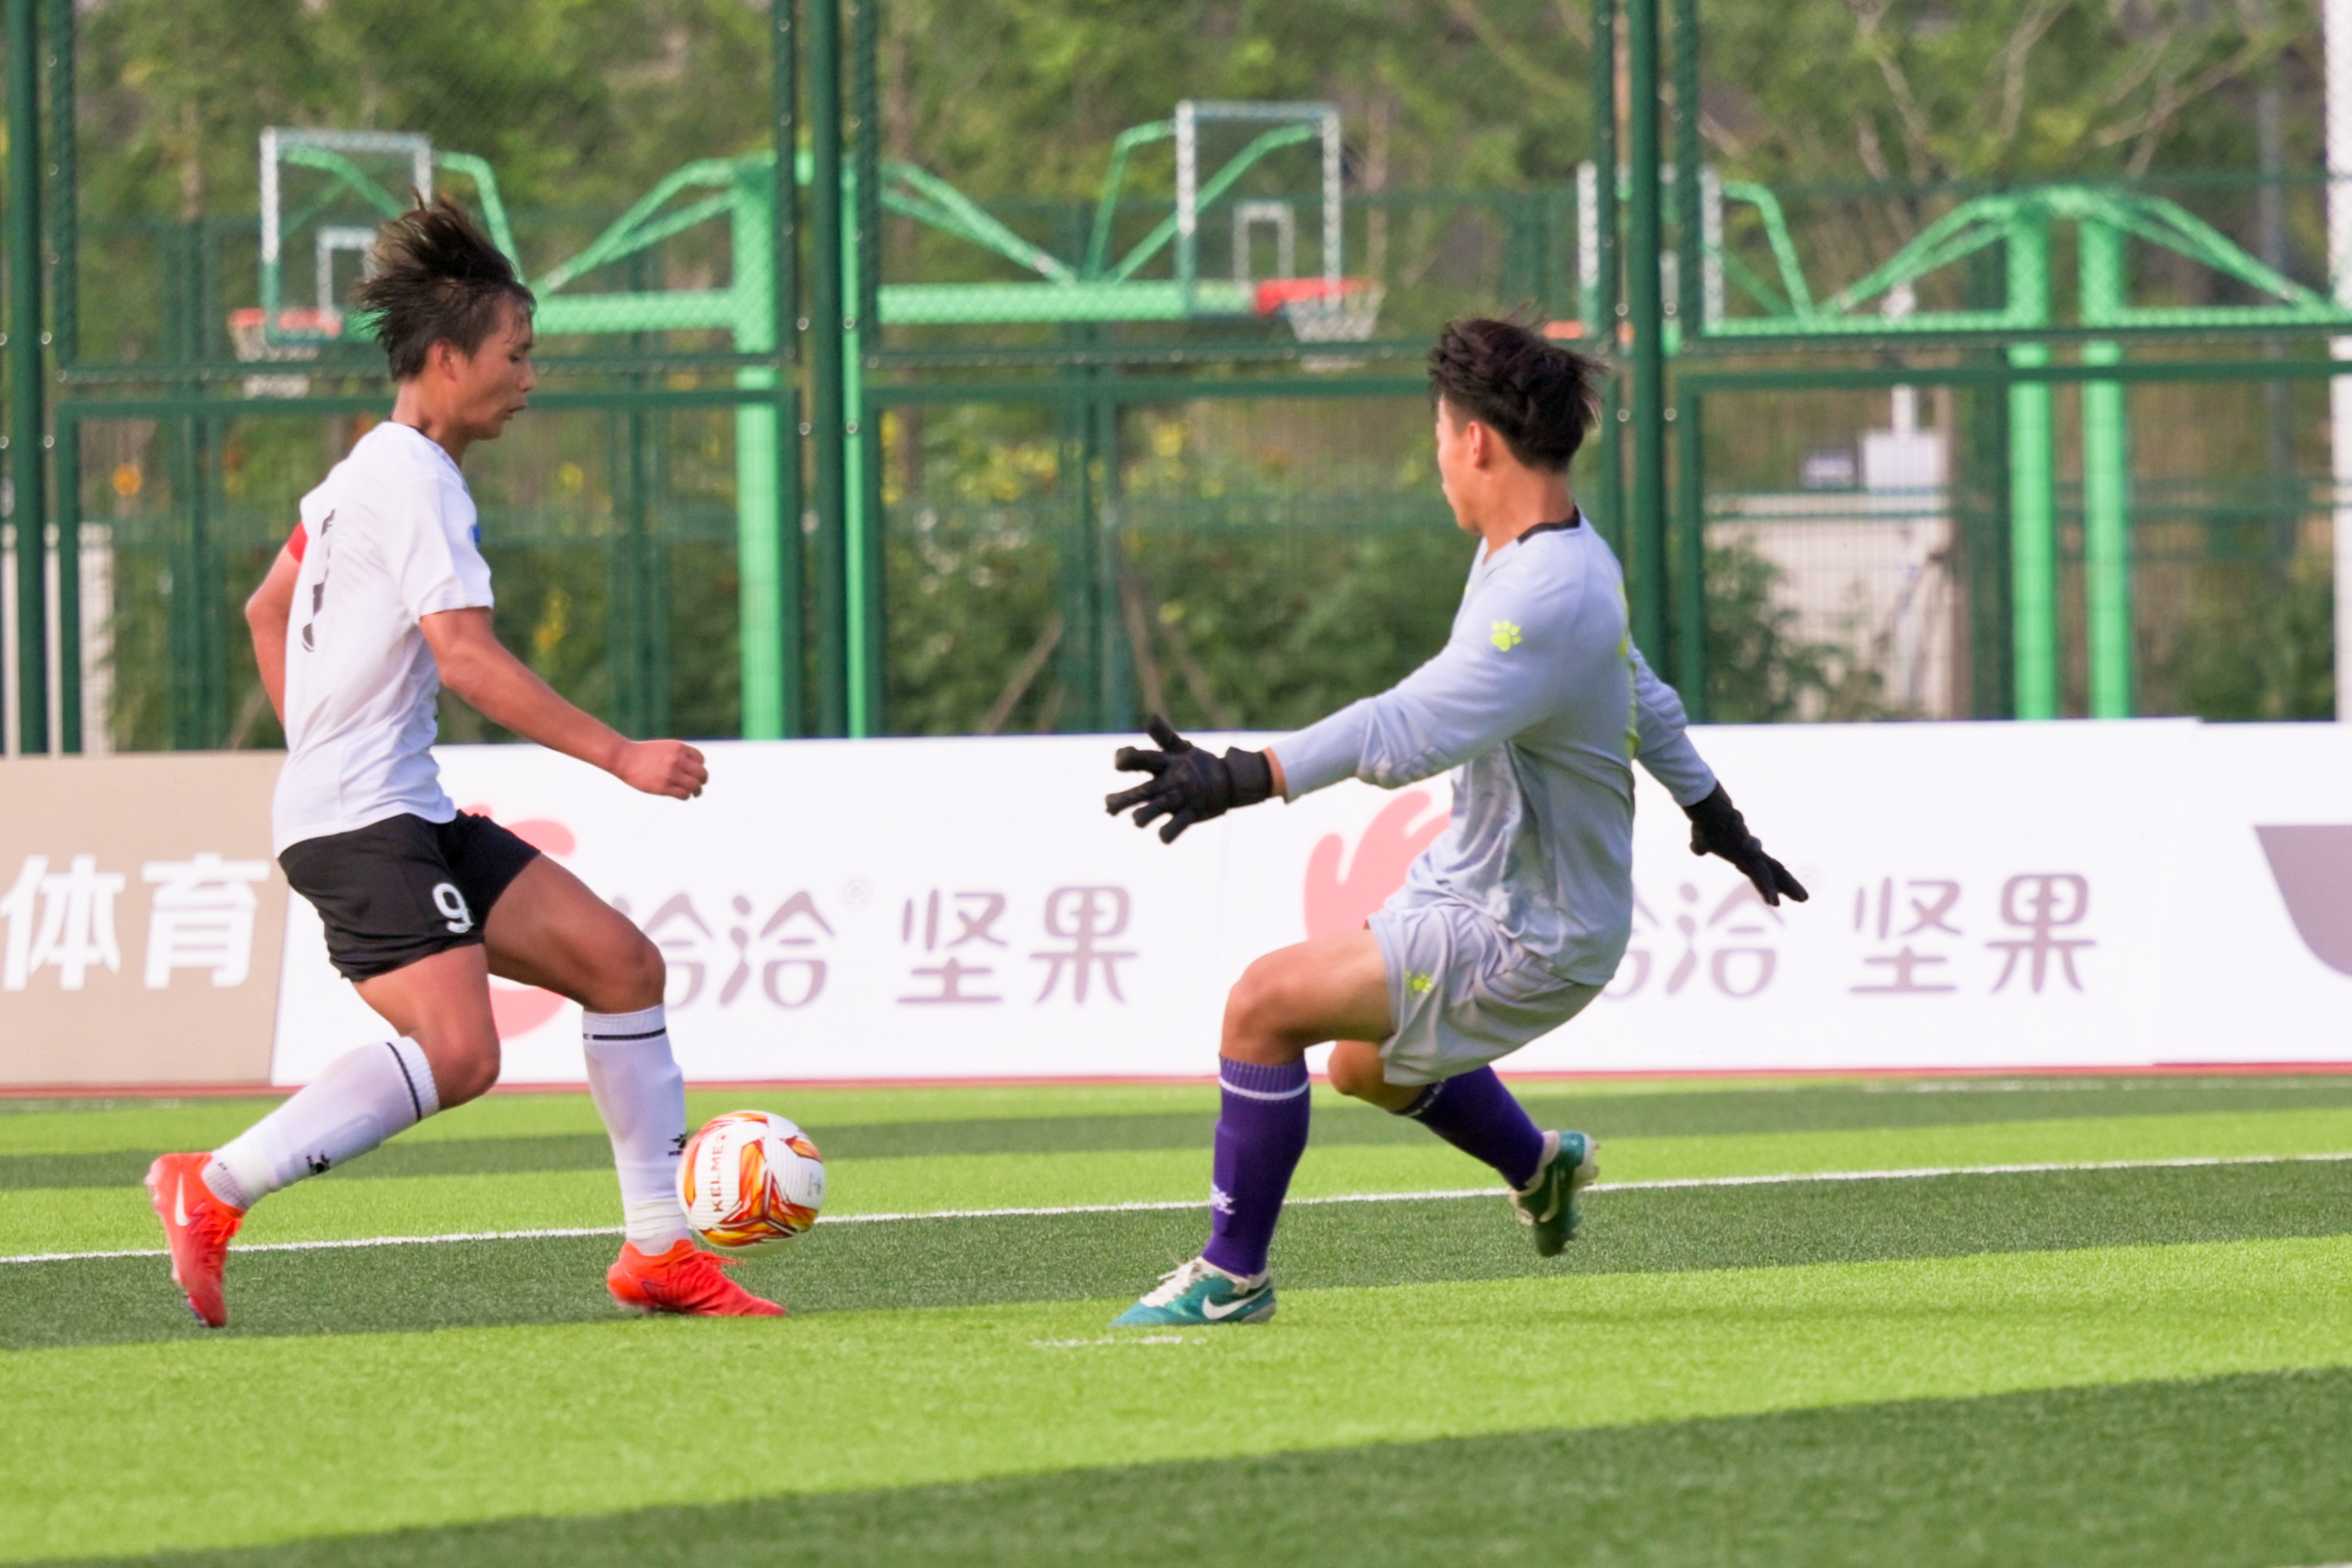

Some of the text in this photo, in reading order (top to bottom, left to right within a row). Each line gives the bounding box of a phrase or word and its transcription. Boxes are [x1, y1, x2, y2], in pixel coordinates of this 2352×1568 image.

[1, 854, 270, 991] 体育
[432, 882, 473, 933] 9
[710, 1144, 724, 1213] KELME
